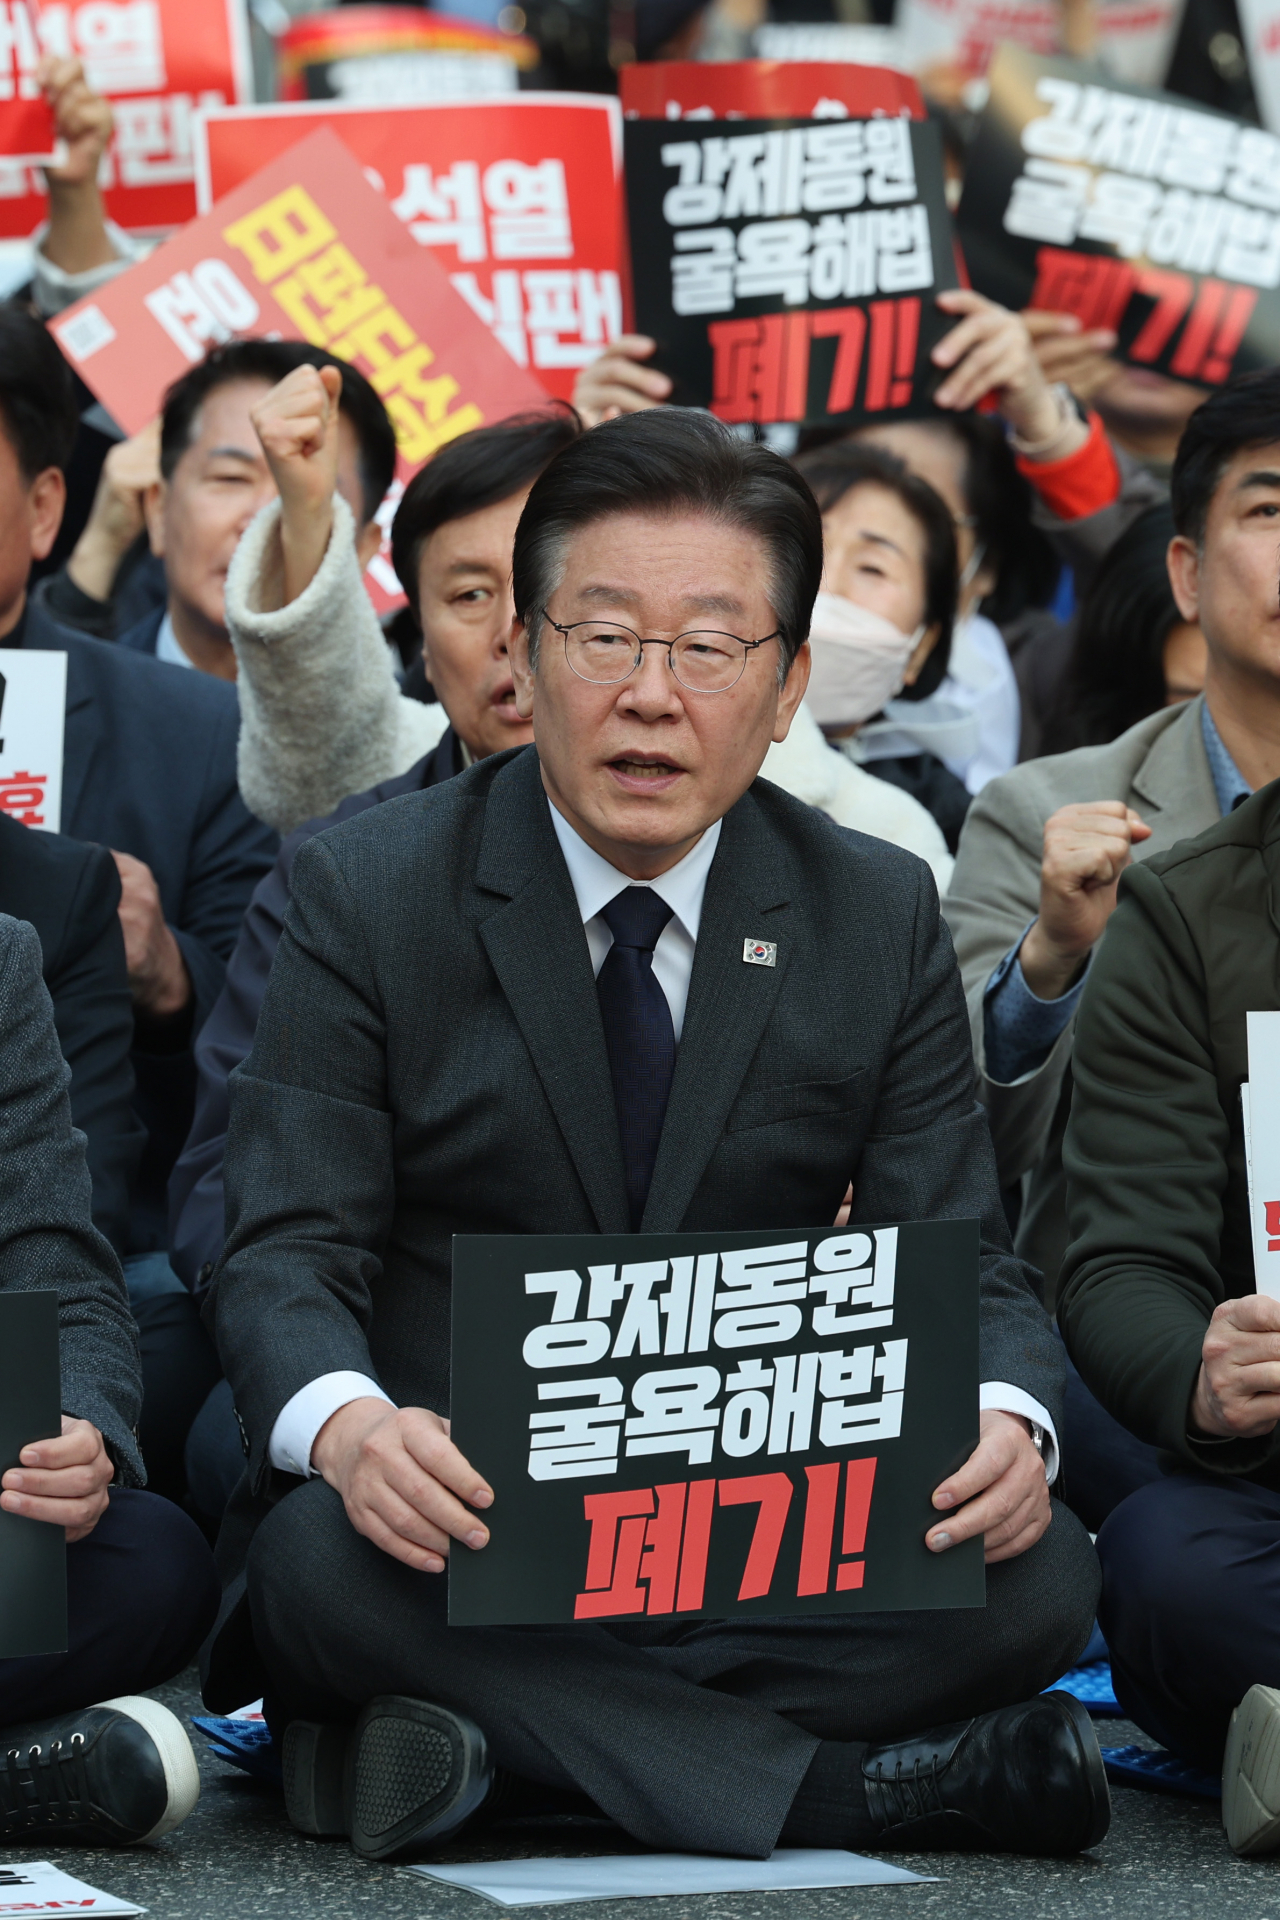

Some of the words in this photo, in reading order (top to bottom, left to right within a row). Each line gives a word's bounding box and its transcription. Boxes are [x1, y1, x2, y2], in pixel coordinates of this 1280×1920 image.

[661, 116, 917, 226] 강제동원
[1021, 76, 1280, 210] 강제동원
[363, 157, 574, 263] 석열
[670, 204, 934, 316] 굴욕해법
[707, 296, 922, 425] 폐기!
[522, 1226, 899, 1369] 강제동원
[527, 1338, 909, 1482] 굴욕해법
[573, 1456, 878, 1621] 폐기!
